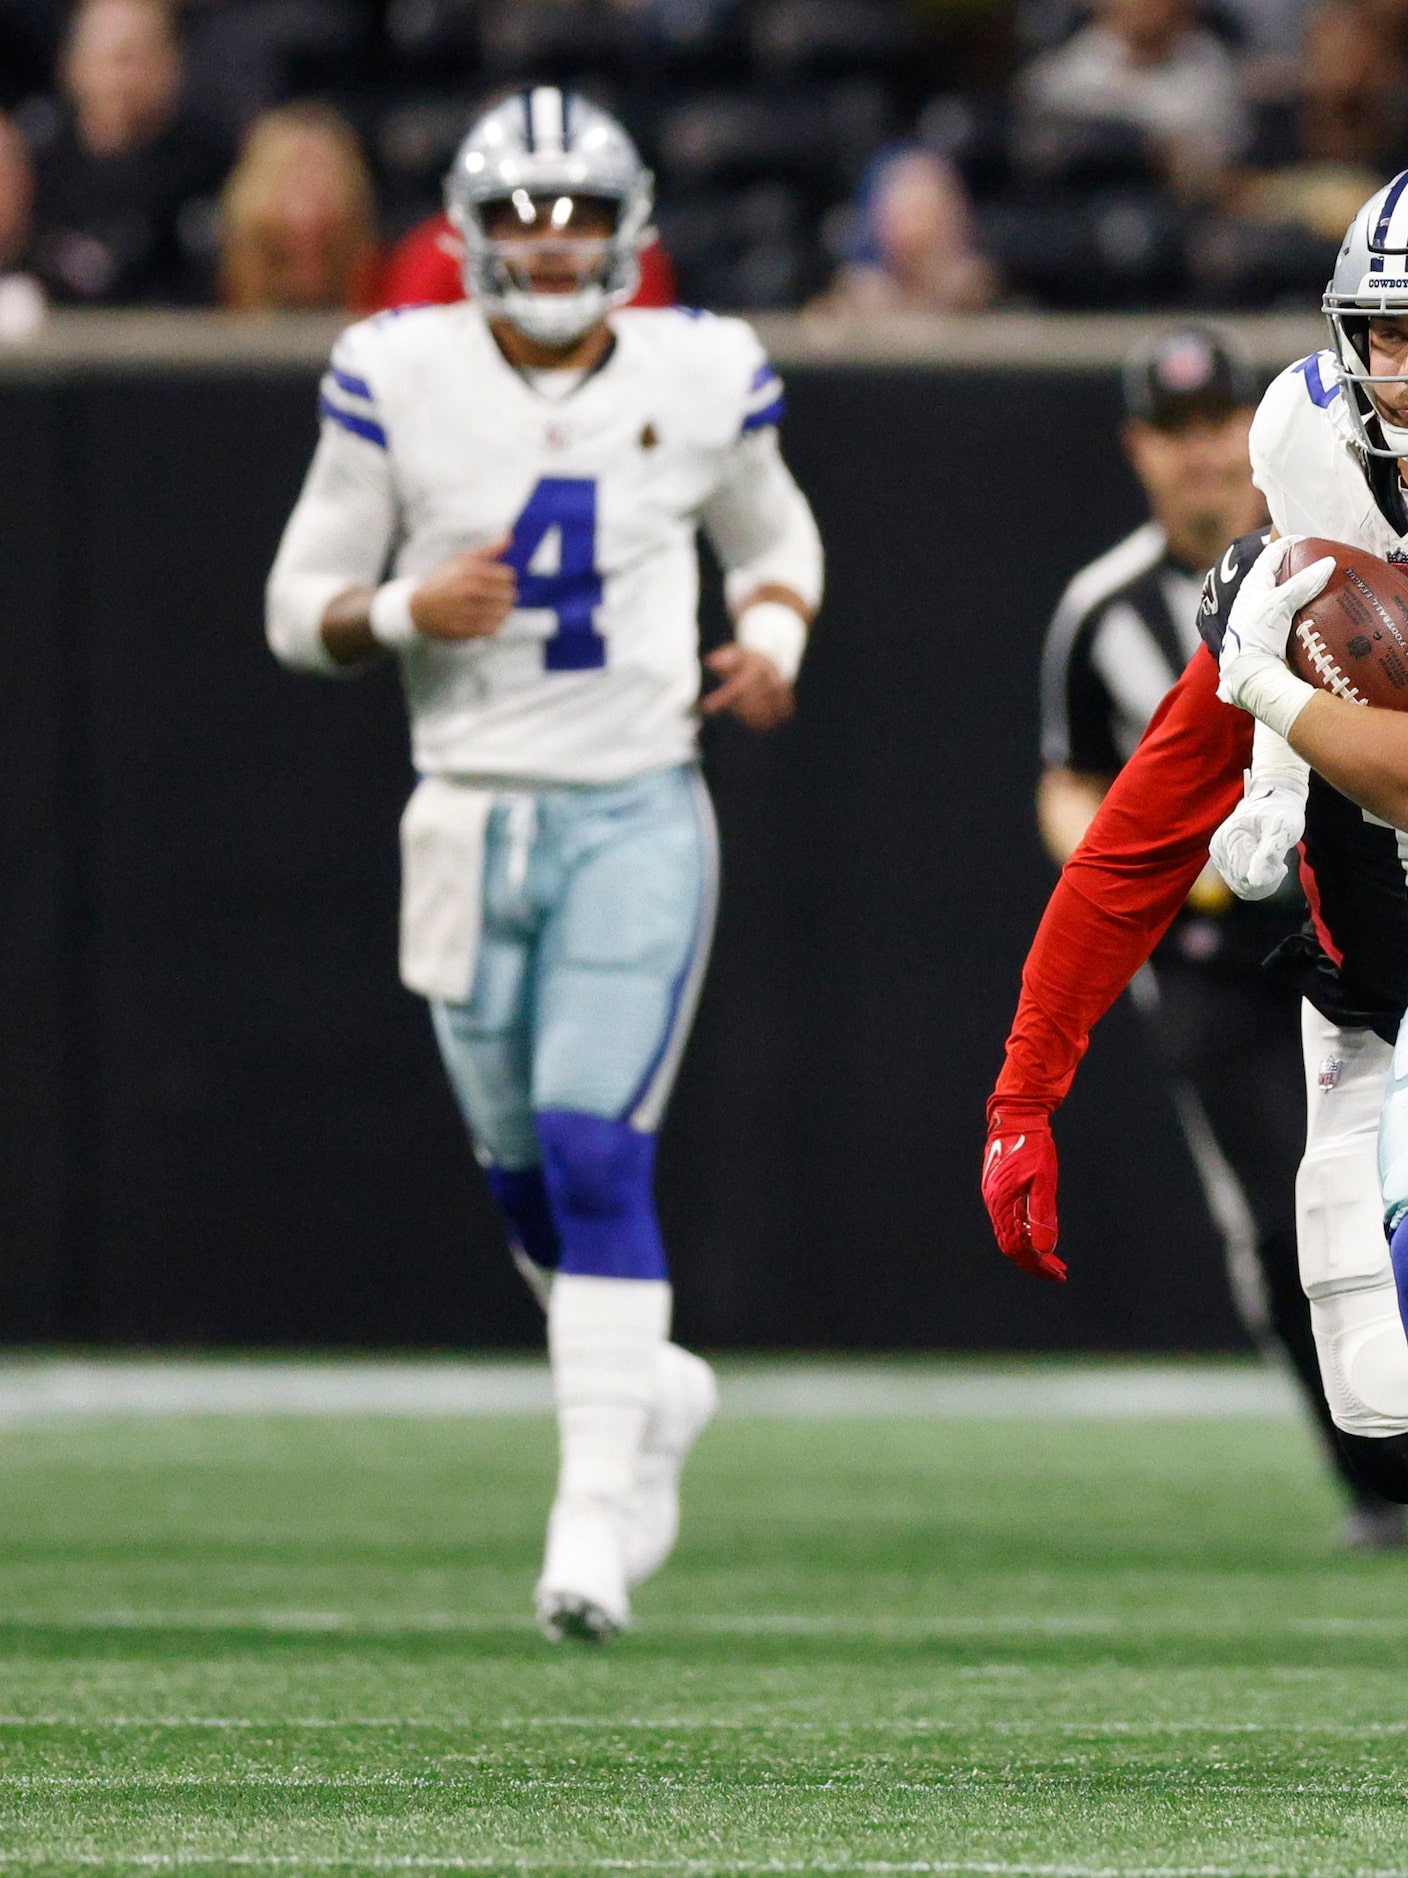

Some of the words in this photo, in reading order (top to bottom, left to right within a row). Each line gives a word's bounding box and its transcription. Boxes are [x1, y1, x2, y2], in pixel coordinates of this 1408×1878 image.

[500, 476, 606, 671] 4
[1343, 567, 1373, 599] LEAGUE
[1371, 597, 1407, 647] FOOTBALL
